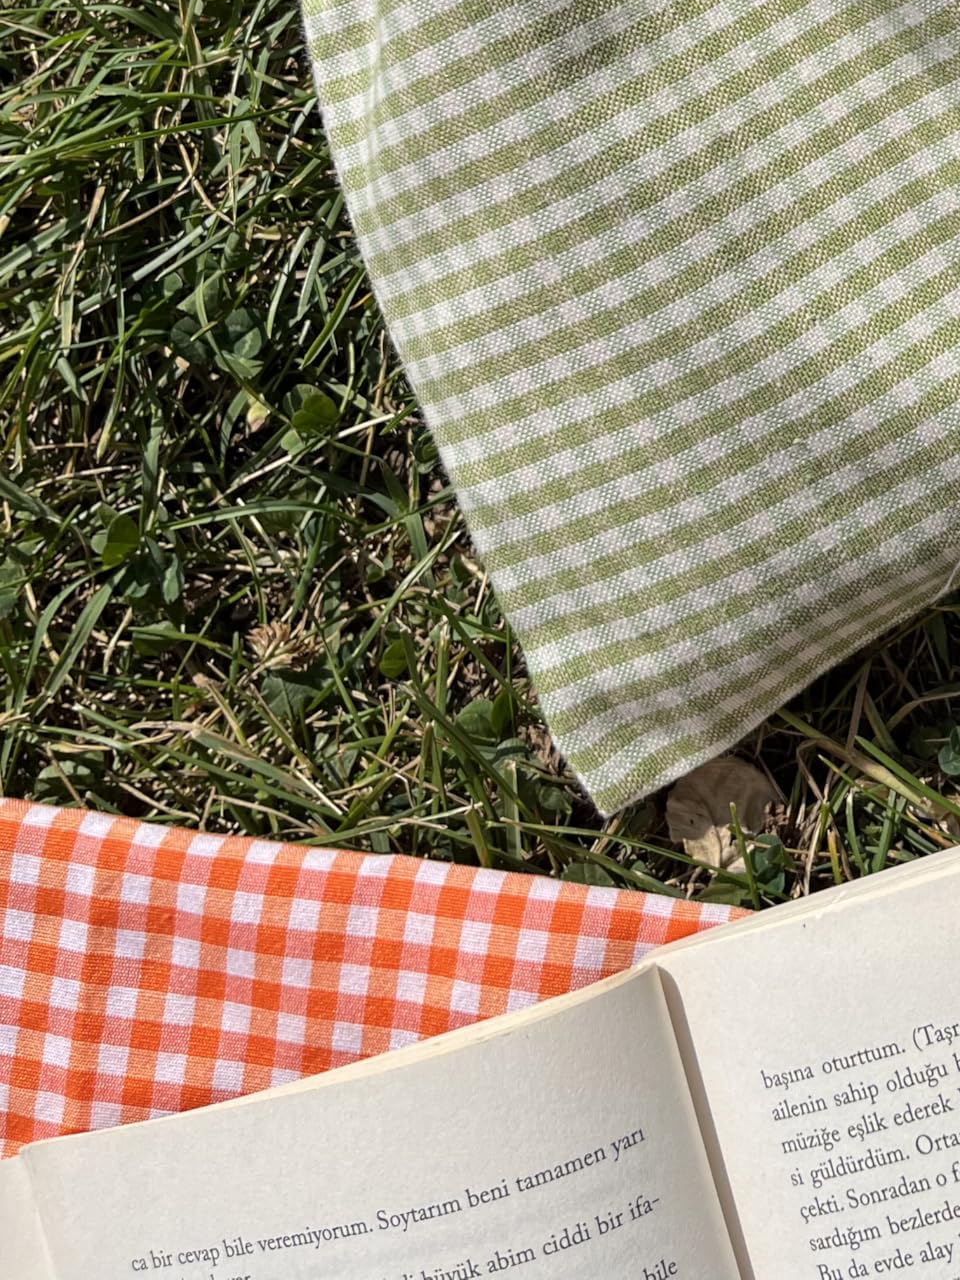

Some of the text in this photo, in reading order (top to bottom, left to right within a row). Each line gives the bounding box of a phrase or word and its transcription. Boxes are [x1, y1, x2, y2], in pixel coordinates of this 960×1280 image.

[760, 1065, 815, 1091] başına
[821, 1042, 906, 1075] oturttum.
[771, 1095, 829, 1122] ailenin
[833, 1081, 879, 1107] sahip
[885, 1063, 950, 1093] olduğu
[780, 1127, 841, 1155] müziğe
[847, 1111, 889, 1143] eşlik
[893, 1093, 955, 1127] ederek
[790, 1167, 805, 1187] si
[809, 1147, 911, 1190] güldürdüm.
[131, 1128, 646, 1272] ca bir cevap bile veremiyorum. Soytarım beni tamamen yarı
[799, 1194, 845, 1225] çekti.
[845, 1175, 932, 1209] Sonradan
[935, 1173, 948, 1188] o
[486, 1248, 537, 1274] abim
[542, 1222, 593, 1256] ciddi
[594, 1211, 624, 1236] bir
[628, 1194, 660, 1221] ifa-
[808, 1225, 883, 1252] sardığım
[642, 1259, 678, 1280] bile
[815, 1263, 844, 1280] Bu
[847, 1258, 870, 1280] da
[873, 1247, 915, 1274] evde
[919, 1240, 954, 1265] alay
